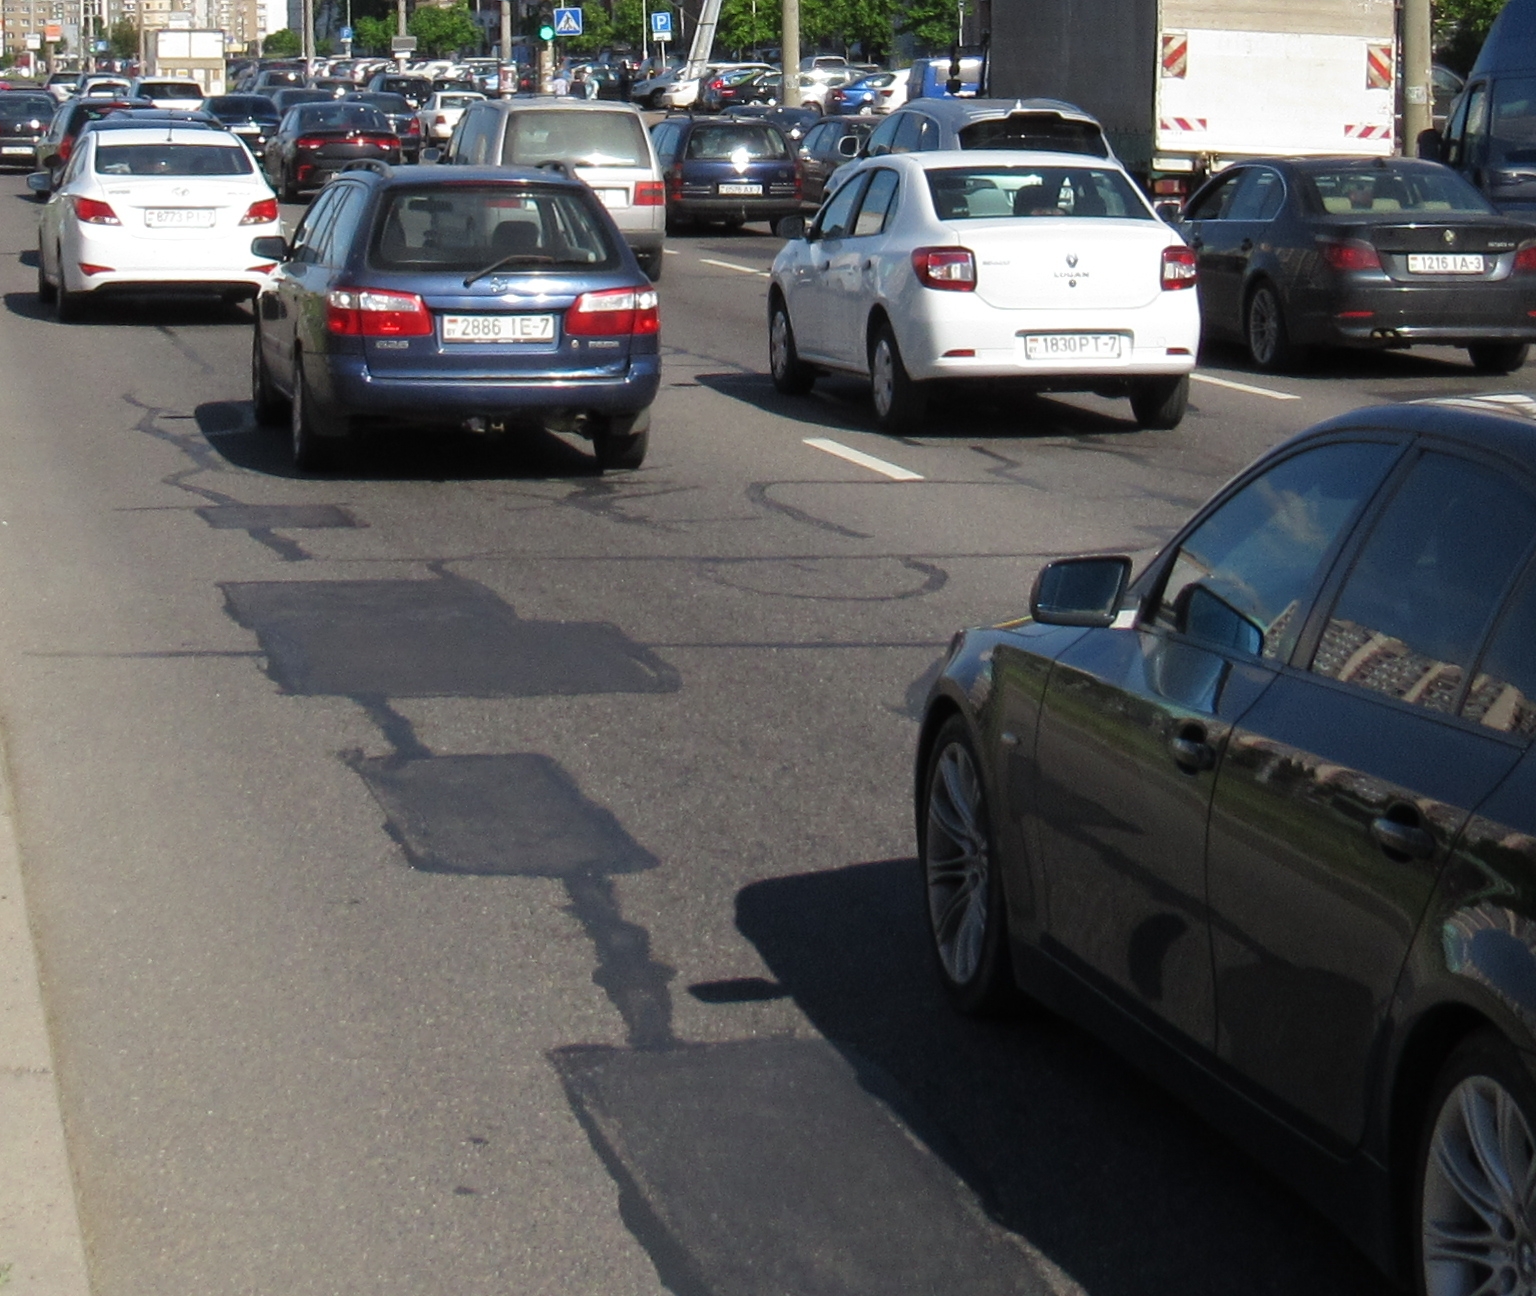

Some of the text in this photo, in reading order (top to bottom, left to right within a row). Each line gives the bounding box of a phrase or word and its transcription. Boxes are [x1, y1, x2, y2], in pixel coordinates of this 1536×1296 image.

[1421, 256, 1449, 270] 1216
[460, 317, 551, 337] 2886 IE-7
[1043, 336, 1077, 353] 1830
